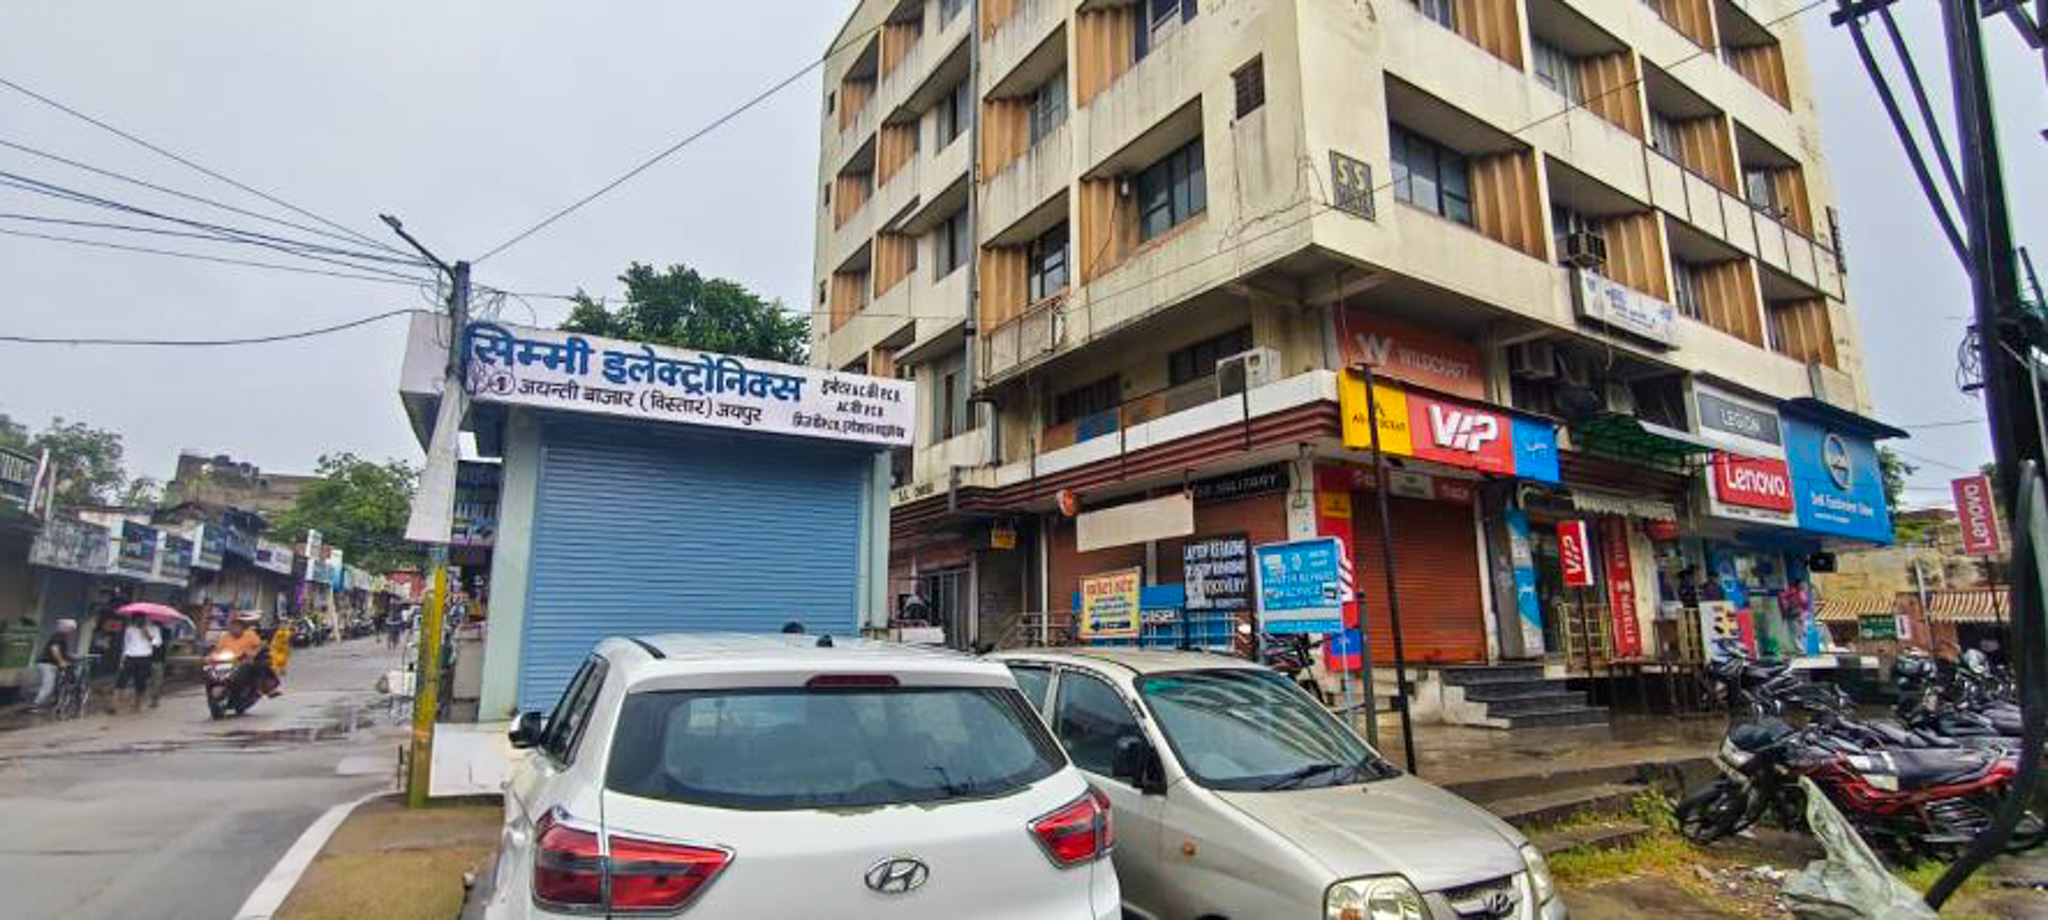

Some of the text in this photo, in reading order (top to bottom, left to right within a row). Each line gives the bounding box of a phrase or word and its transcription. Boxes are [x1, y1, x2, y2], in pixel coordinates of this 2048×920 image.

[463, 322, 596, 375] सिम्मी
[583, 387, 635, 408] बाजार
[716, 402, 763, 426] जयपुर
[1719, 408, 1760, 436] LEGION
[1428, 404, 1498, 453] VIP
[1723, 455, 1786, 497] Lenovo
[1963, 483, 1991, 548] Lenovo
[1561, 535, 1583, 575] VIP
